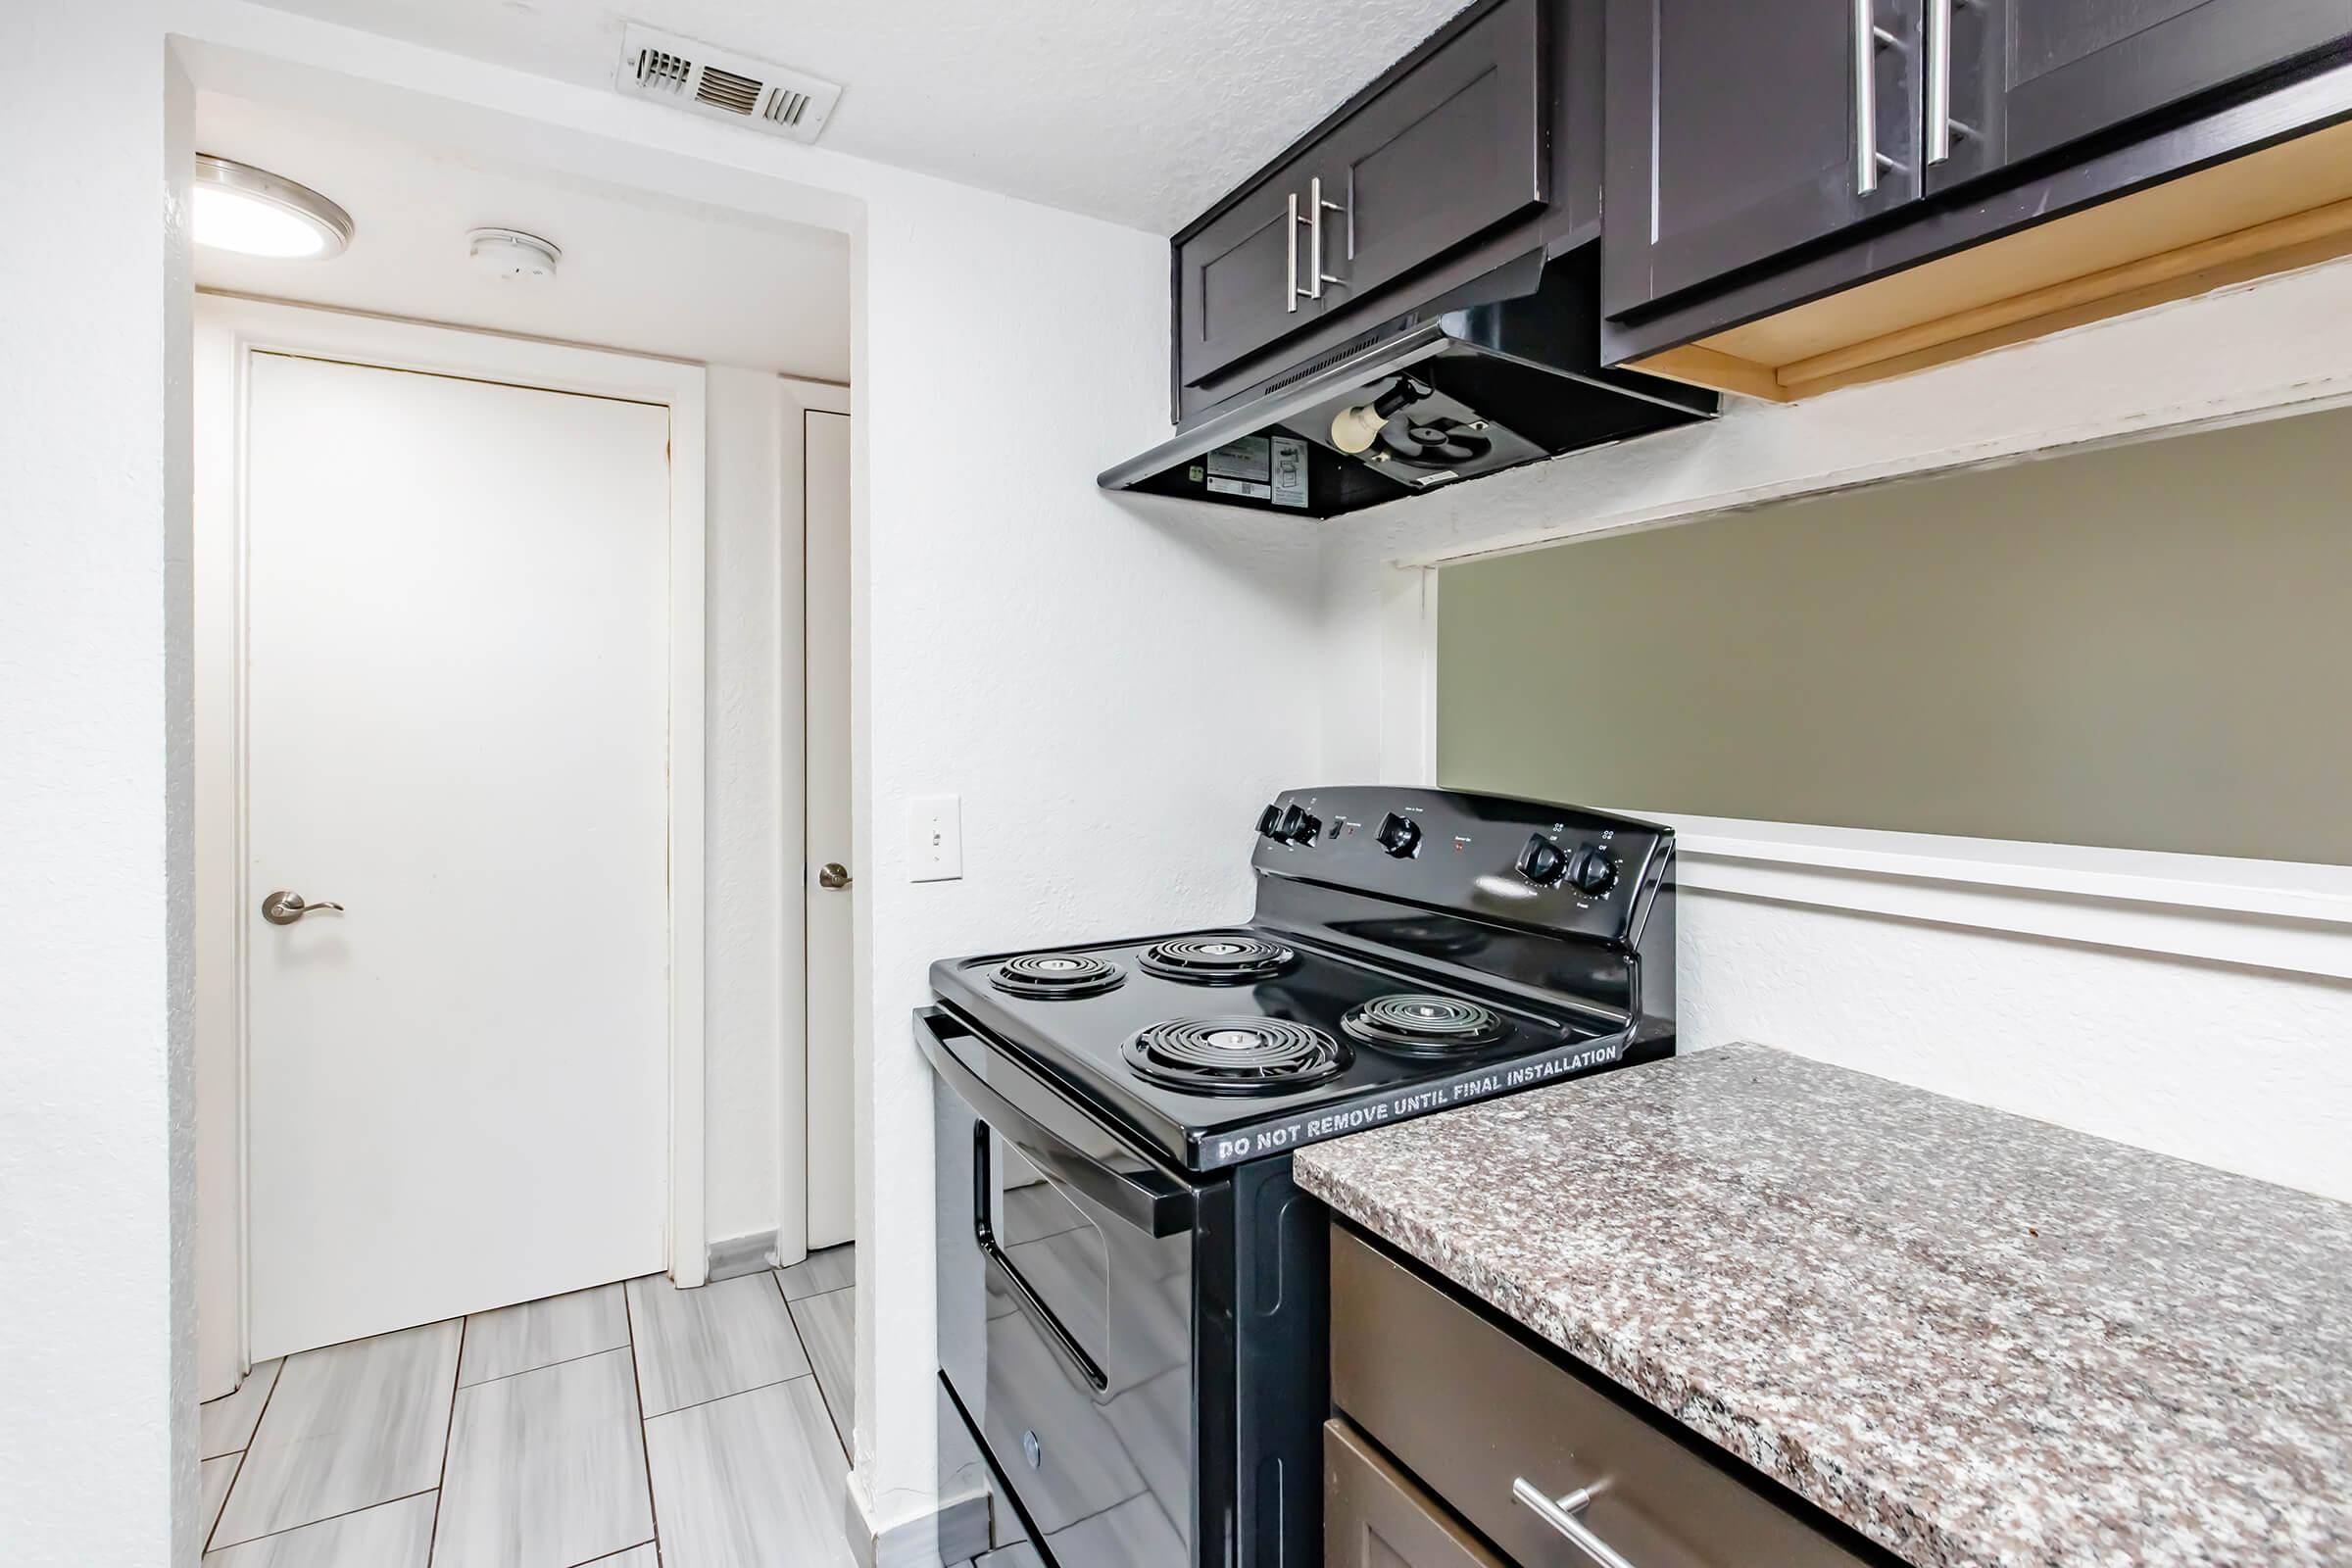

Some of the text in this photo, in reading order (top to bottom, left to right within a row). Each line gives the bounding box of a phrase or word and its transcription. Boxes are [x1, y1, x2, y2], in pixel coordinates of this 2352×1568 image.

[1218, 1045, 1617, 1159] DO NOT REMOVE UNTIL FINAL INSTALLATION
